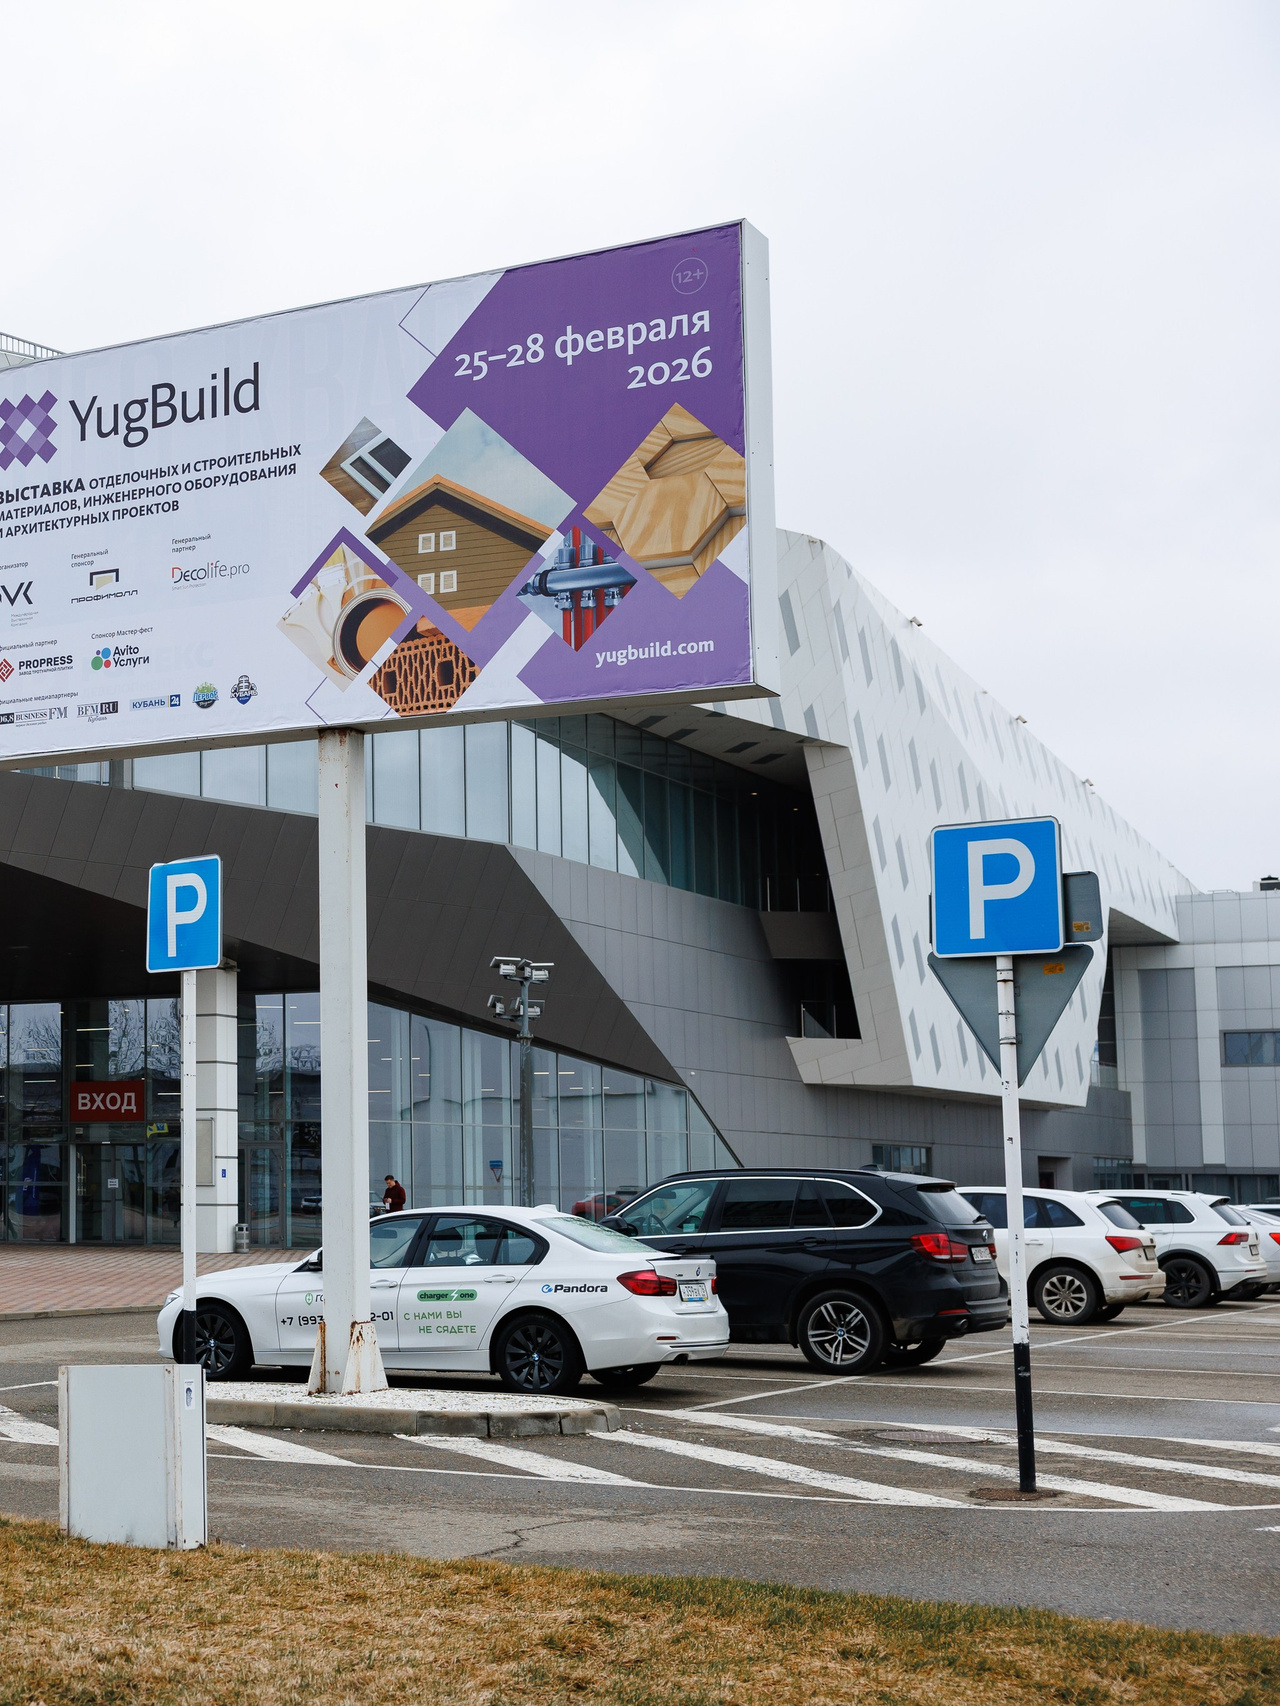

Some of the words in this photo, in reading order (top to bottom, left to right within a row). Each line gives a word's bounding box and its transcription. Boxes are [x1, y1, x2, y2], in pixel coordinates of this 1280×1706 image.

[675, 267, 704, 285] 12+
[554, 310, 711, 365] февраля
[627, 345, 713, 389] 2026
[68, 361, 261, 448] YugBuild
[89, 464, 179, 490] ОТДЕЛОЧНЫХ
[182, 461, 191, 474] И
[193, 444, 302, 475] СТРОИТЕЛЬНЫХ
[83, 482, 182, 508] ИНЖЕНЕРНОГО
[184, 463, 297, 492] ОБОРУДОВАНИЯ
[5, 511, 110, 538] АРХИТЕКТУРНЫХ
[112, 500, 180, 522] ПРОЕКТОВ
[171, 533, 211, 545] Генеральный
[71, 549, 109, 560] Генеральный
[171, 544, 196, 553] партнер
[71, 560, 94, 569] спонсор
[70, 589, 138, 604] ПРОФИМОЛЛ
[91, 631, 116, 640] Спонсор
[116, 626, 153, 637] Мастер-фест
[35, 639, 58, 648] партнер
[113, 645, 139, 657] Avito
[113, 655, 150, 668] Услуги
[595, 640, 715, 668] yugbuild.com
[18, 655, 73, 670] PROPRESS
[33, 691, 79, 702] медиапартнеры
[132, 700, 166, 709] КУБАНЬ
[170, 695, 180, 706] 24
[15, 711, 48, 721] BUSINESS
[48, 706, 68, 720] FM
[967, 838, 1036, 939] P
[166, 872, 208, 957] P
[78, 1092, 136, 1113] ВХОД
[554, 1283, 608, 1293] Pandora
[419, 1291, 449, 1301] charger
[460, 1291, 475, 1299] one
[281, 1316, 294, 1326] +7
[298, 1315, 324, 1327] (993
[370, 1311, 394, 1322] 2-01
[404, 1313, 410, 1321] С
[413, 1311, 442, 1321] НАМИ
[446, 1310, 462, 1320] ВЫ
[419, 1326, 432, 1334] НЕ
[436, 1325, 477, 1334] СЯДЕТЕ
